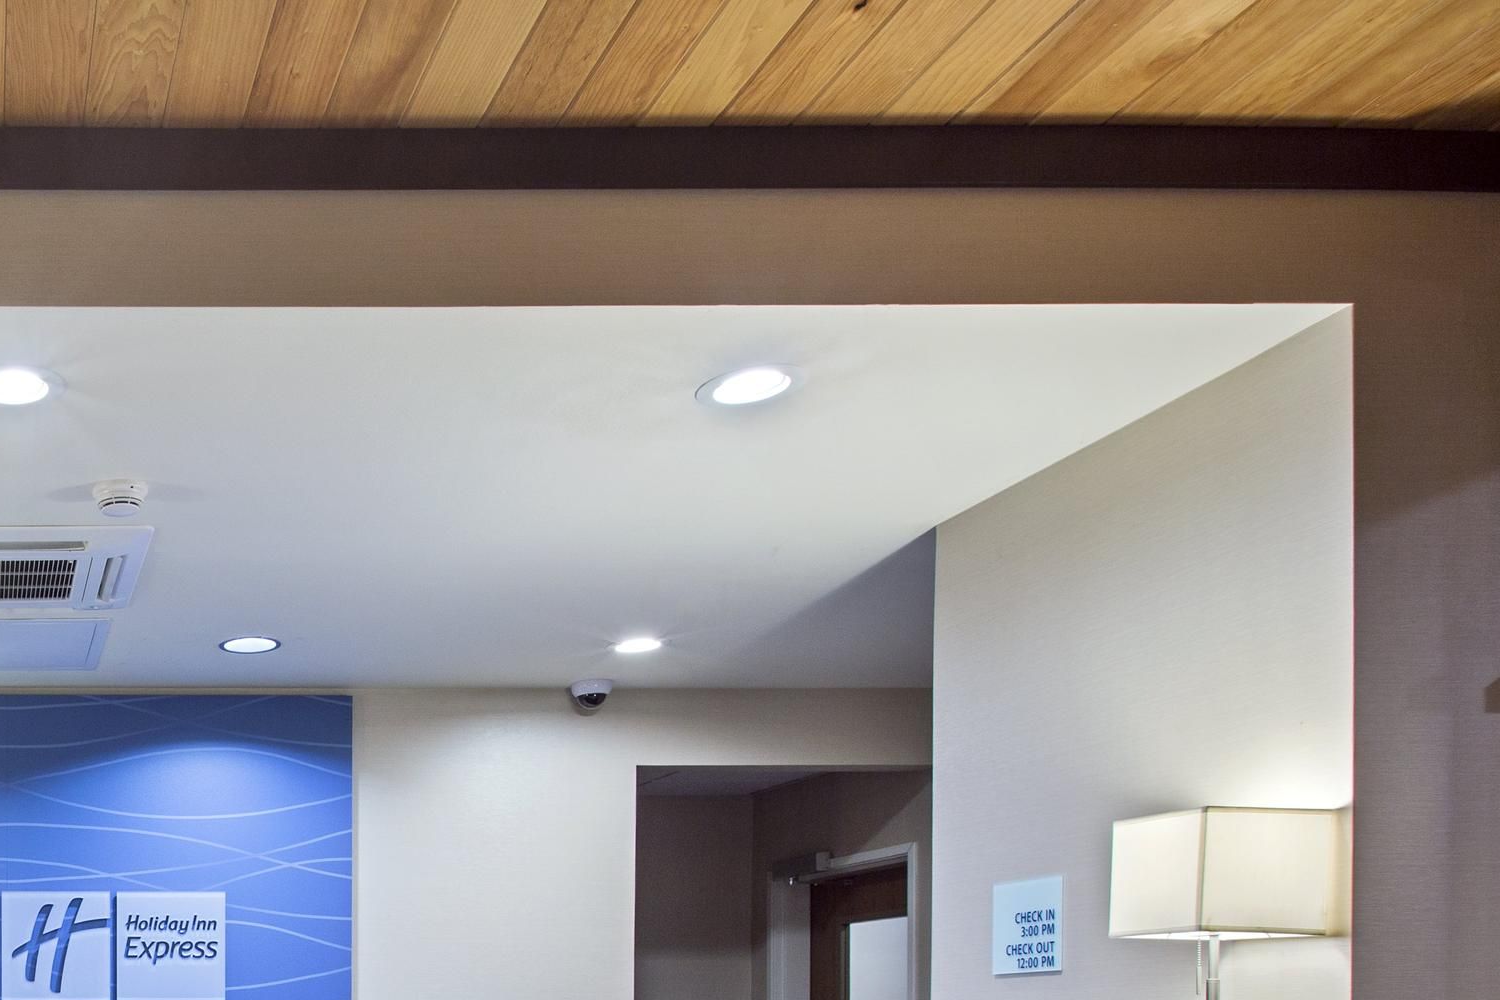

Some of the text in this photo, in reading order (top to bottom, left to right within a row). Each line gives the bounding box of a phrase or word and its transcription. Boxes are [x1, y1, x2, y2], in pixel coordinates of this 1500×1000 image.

[1014, 908, 1055, 924] CHECK IN
[125, 914, 217, 935] Holiday Inn
[1020, 923, 1055, 937] 3:00 PM
[123, 936, 219, 965] Express
[1006, 941, 1055, 956] CHECK OUT
[1017, 955, 1055, 969] 12:00 PM
